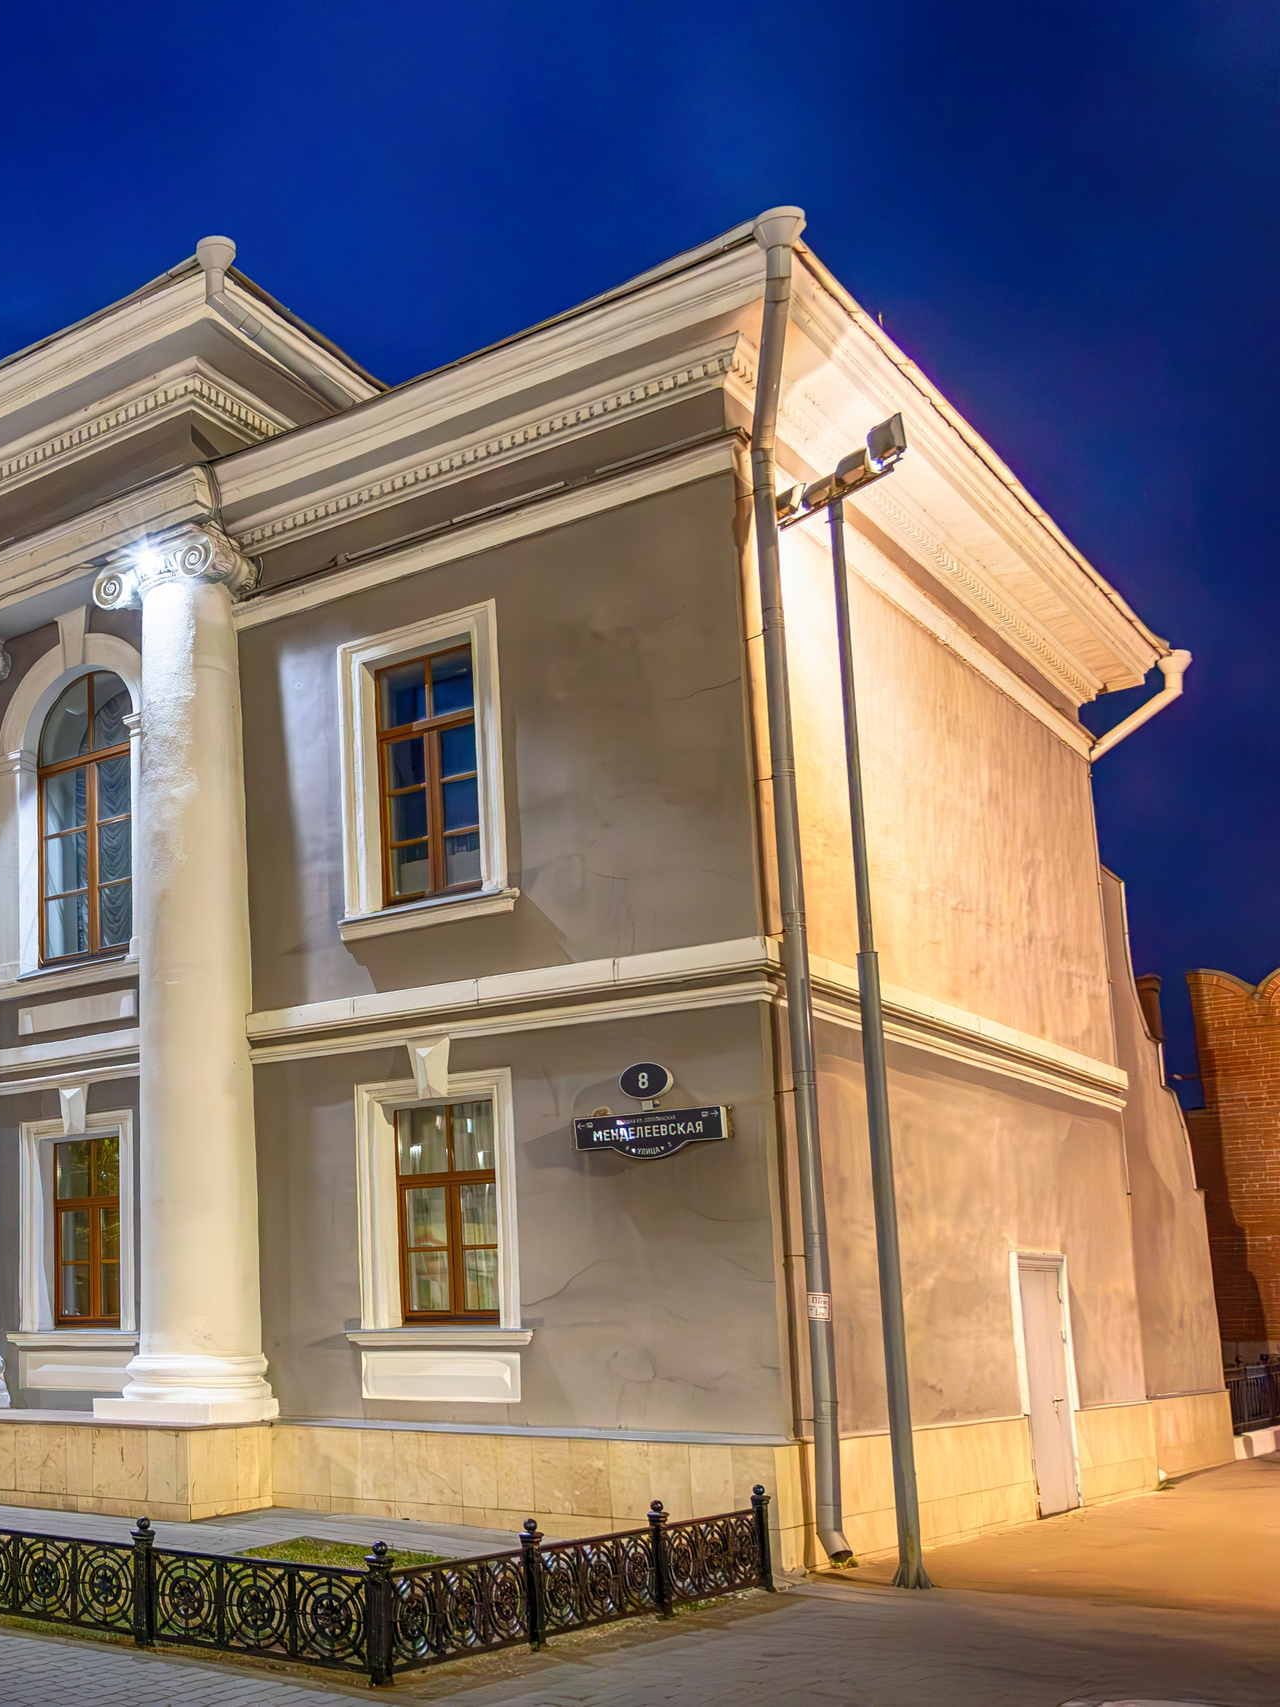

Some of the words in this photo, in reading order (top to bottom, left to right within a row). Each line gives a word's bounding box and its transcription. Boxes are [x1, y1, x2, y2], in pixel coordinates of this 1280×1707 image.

[638, 1072, 649, 1089] 8
[592, 1121, 704, 1142] МЕНДЕЛЕЕВСКАЯ
[637, 1146, 661, 1155] УЛИЦА
